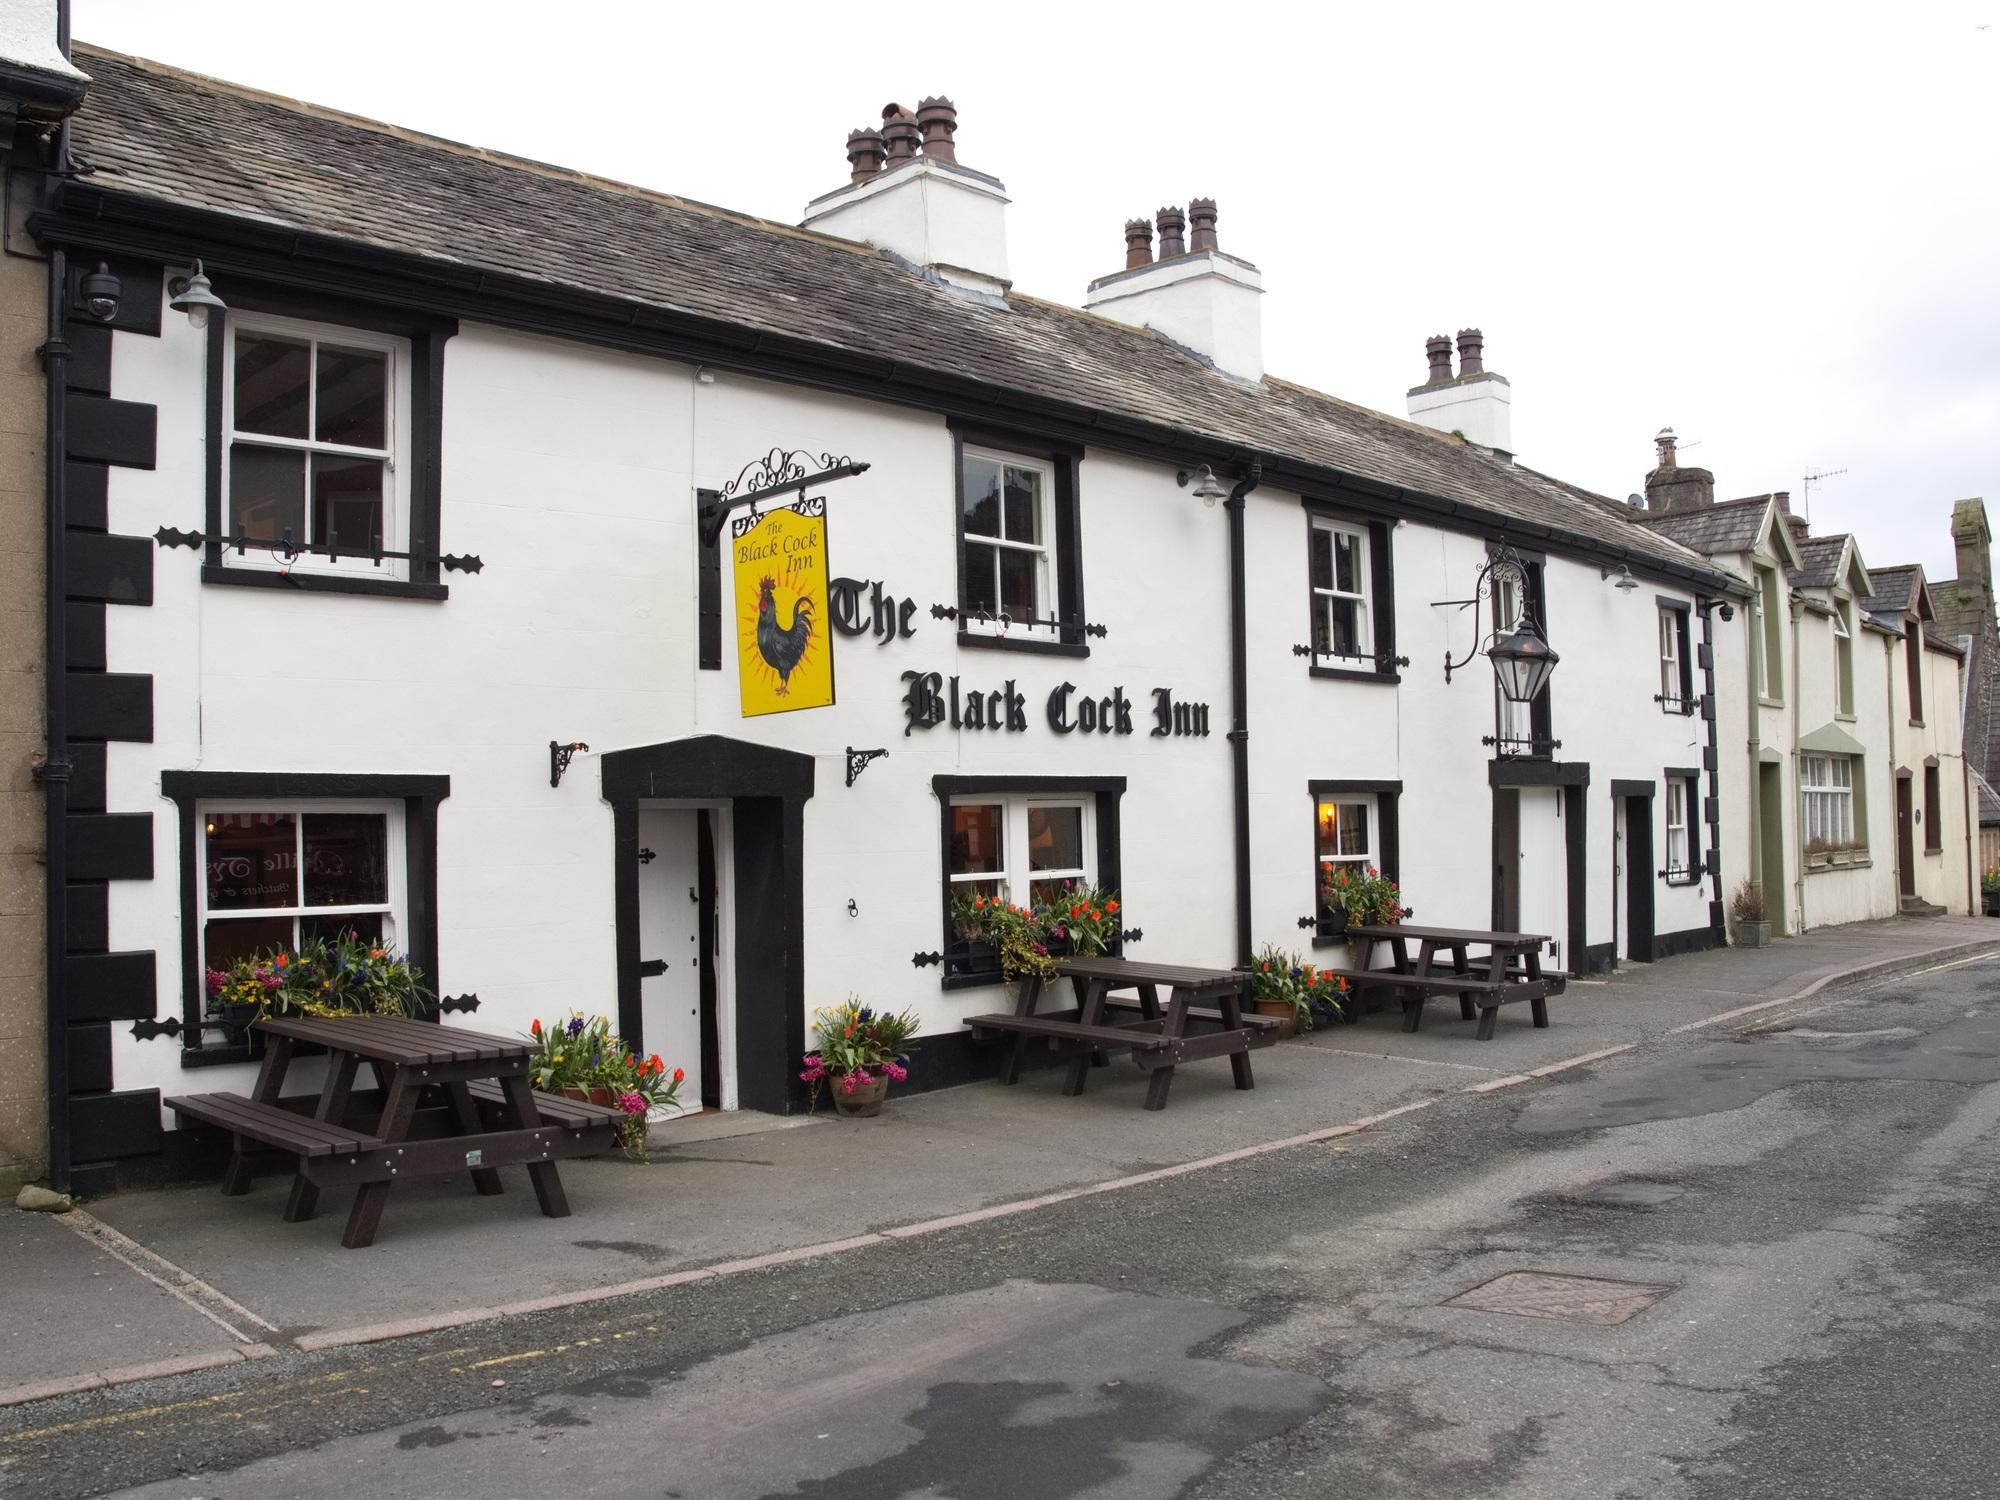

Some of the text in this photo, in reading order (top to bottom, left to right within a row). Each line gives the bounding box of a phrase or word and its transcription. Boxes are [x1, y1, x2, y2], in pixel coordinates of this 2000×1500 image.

[738, 526, 817, 564] Black Cock
[766, 521, 783, 536] The
[786, 554, 813, 573] Inn
[830, 577, 918, 646] The
[901, 670, 1211, 737] Black Cock Inn
